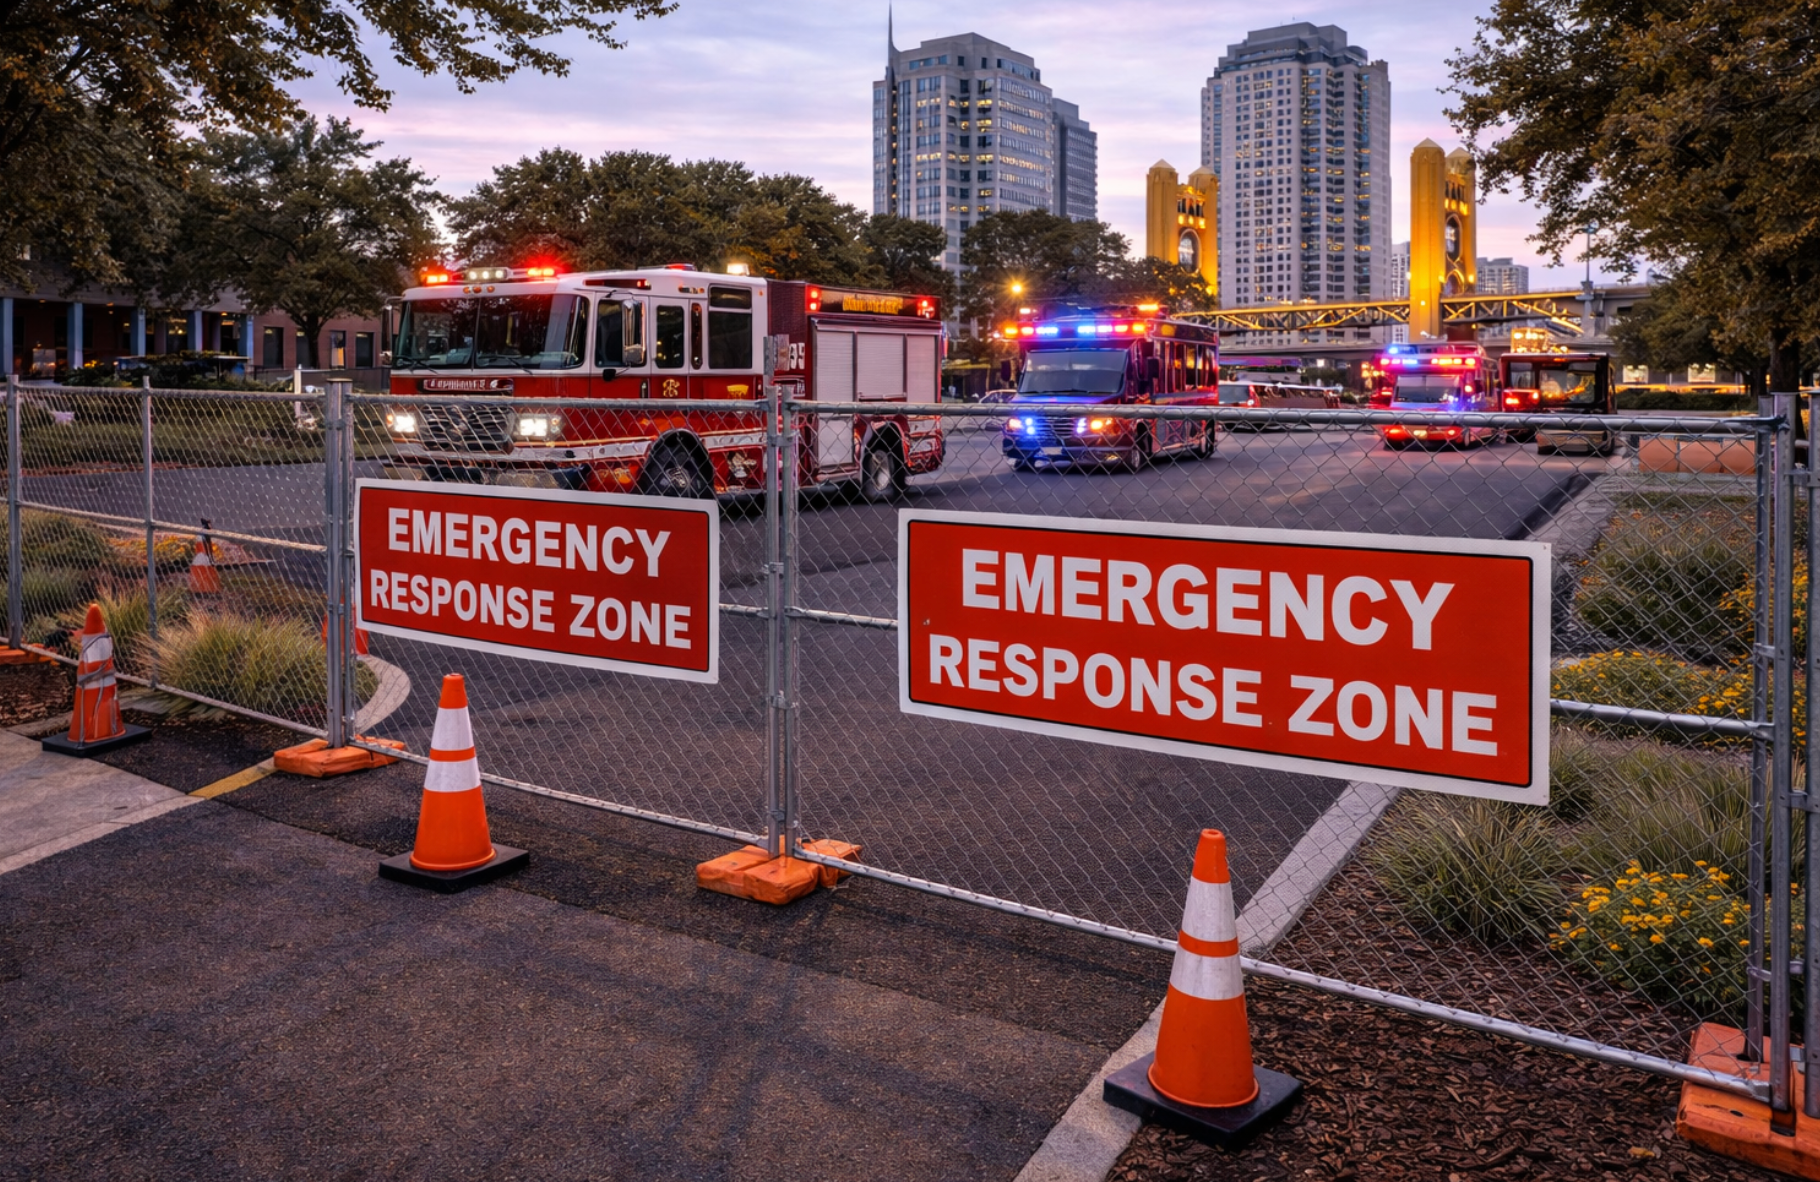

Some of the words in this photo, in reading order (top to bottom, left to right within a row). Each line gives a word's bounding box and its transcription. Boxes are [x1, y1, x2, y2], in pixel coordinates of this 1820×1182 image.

[388, 507, 670, 578] EMERGENCY
[370, 569, 555, 633] RESPONSE
[569, 594, 692, 649] ZONE
[962, 548, 1455, 651] EMERGENCY
[929, 633, 1263, 728] RESPONSE
[1288, 674, 1498, 757] ZONE
